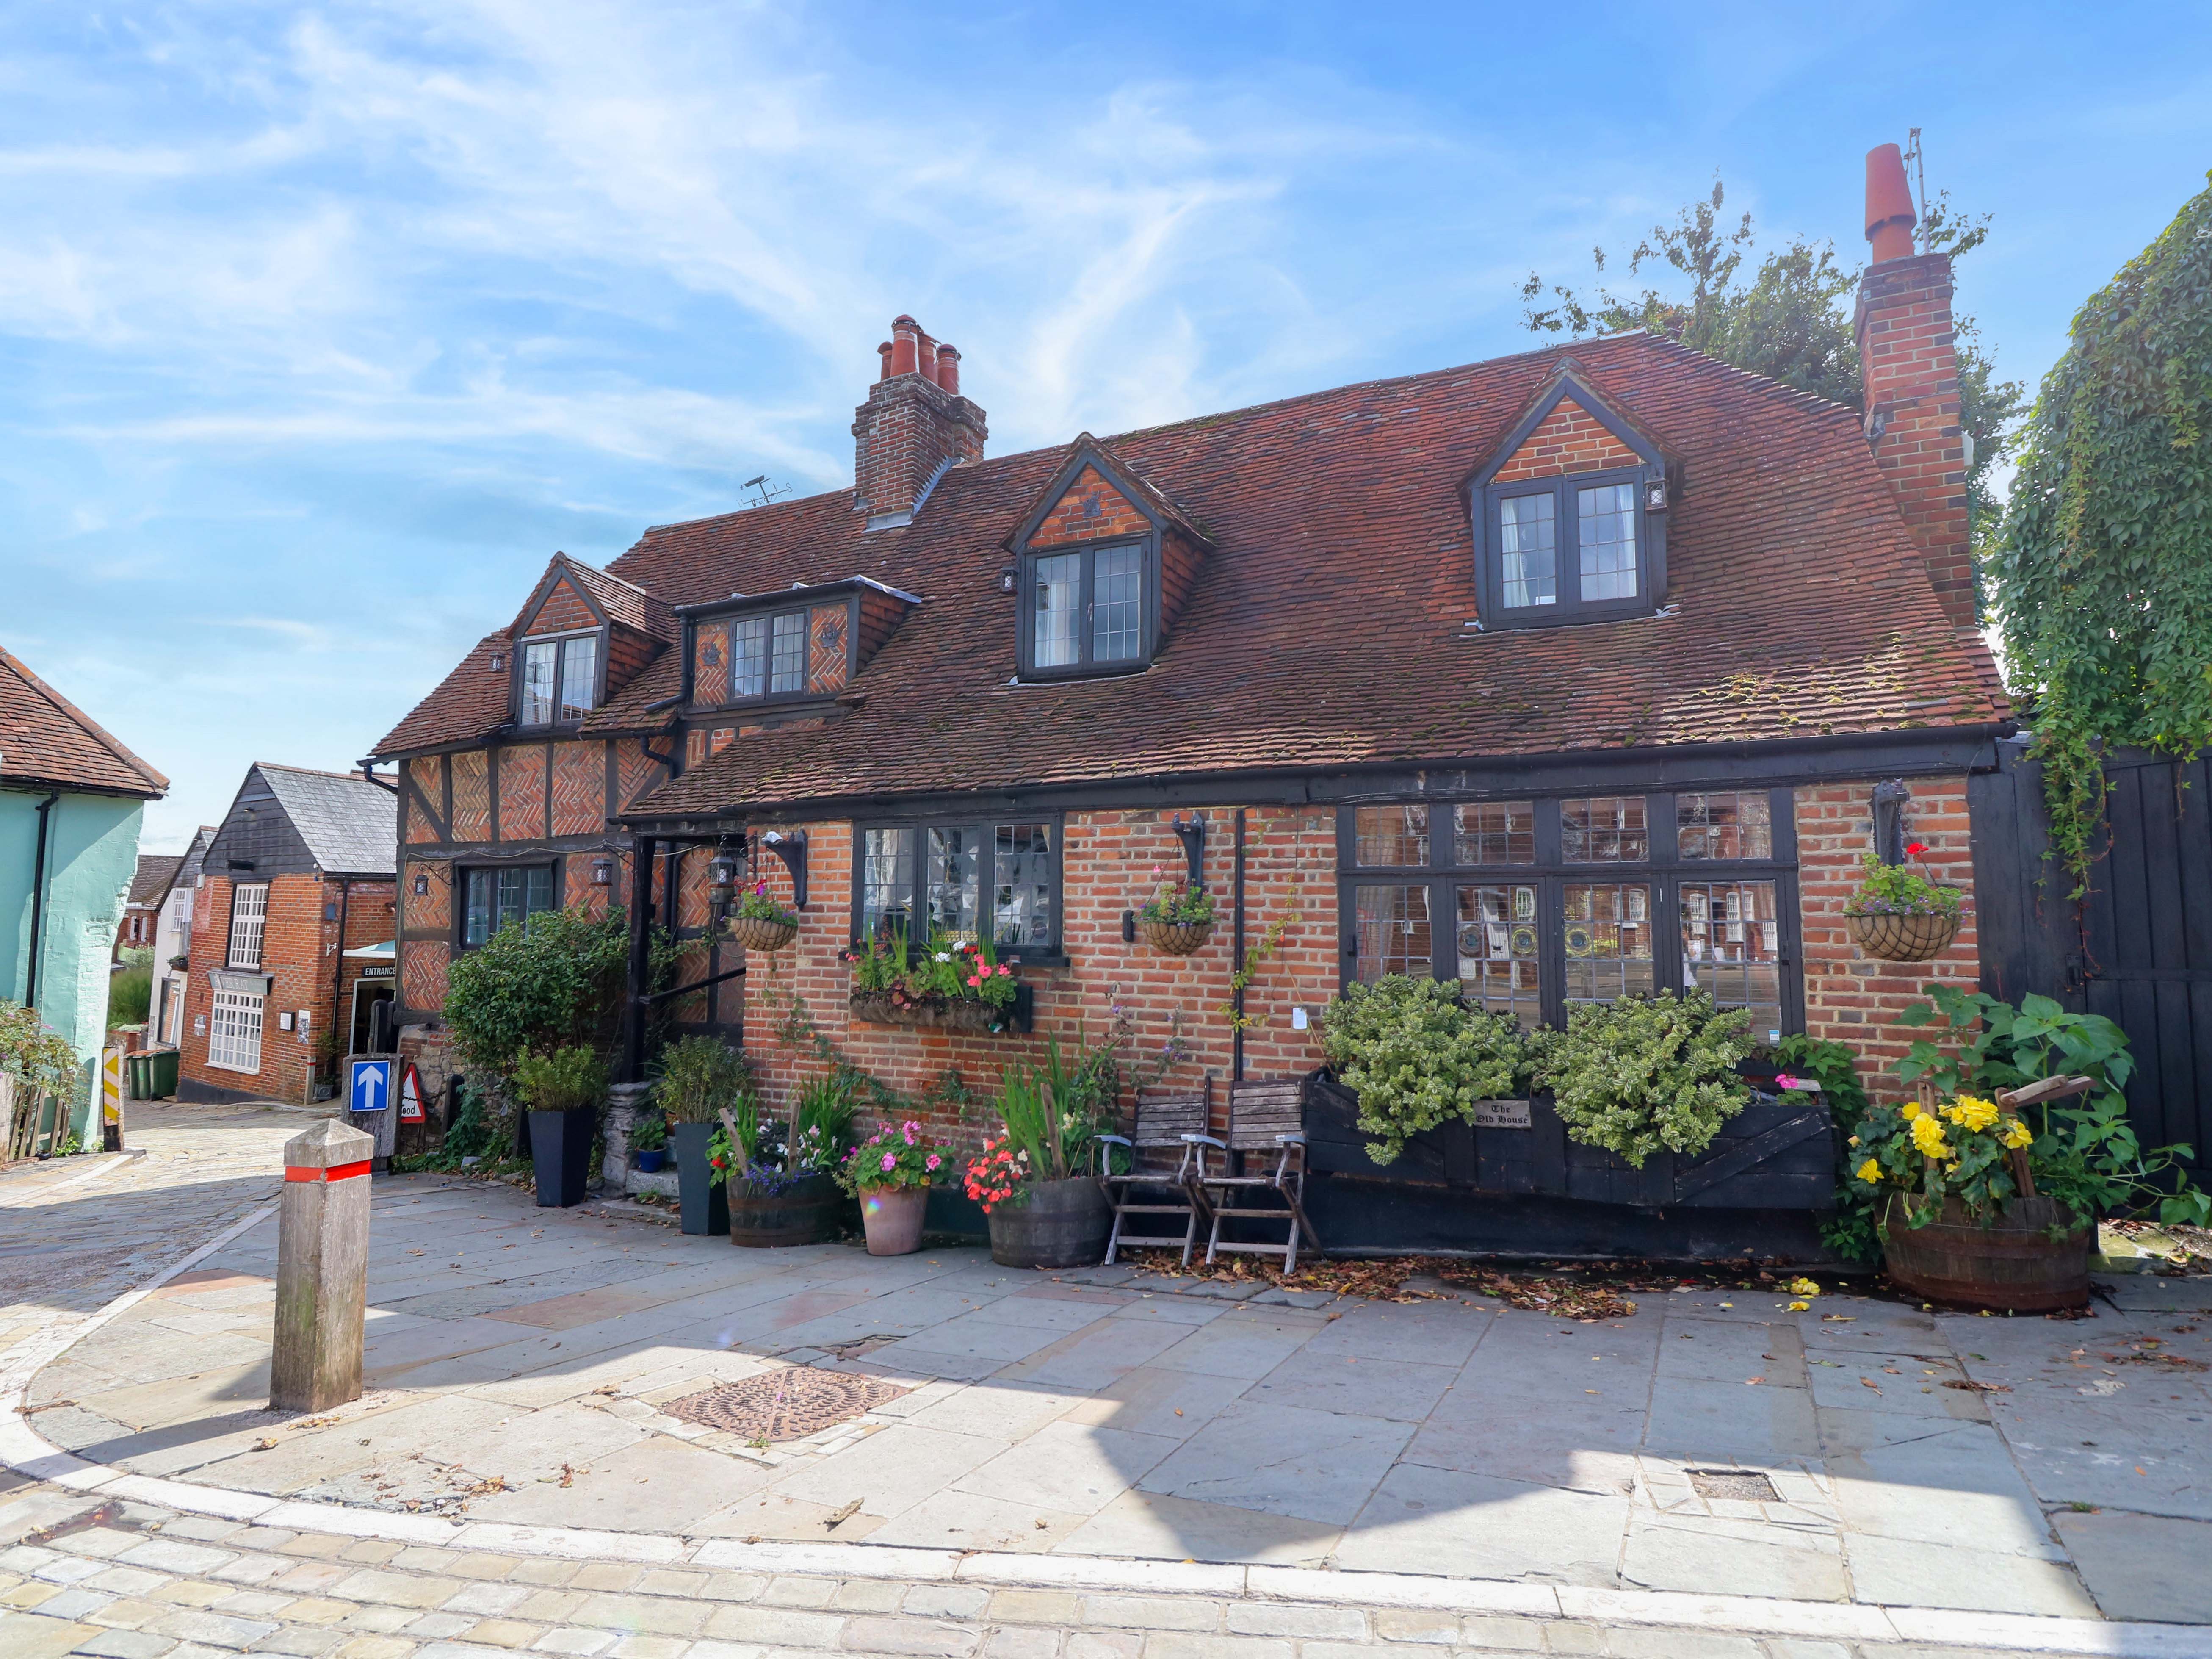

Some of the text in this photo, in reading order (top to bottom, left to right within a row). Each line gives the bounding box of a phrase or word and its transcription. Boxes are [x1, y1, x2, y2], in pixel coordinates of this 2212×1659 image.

[365, 967, 396, 976] ENTRANCE
[213, 975, 235, 989] RVER
[235, 978, 249, 990] RAT
[402, 1105, 415, 1114] ood
[1491, 1105, 1510, 1113] The
[1497, 1115, 1528, 1124] House
